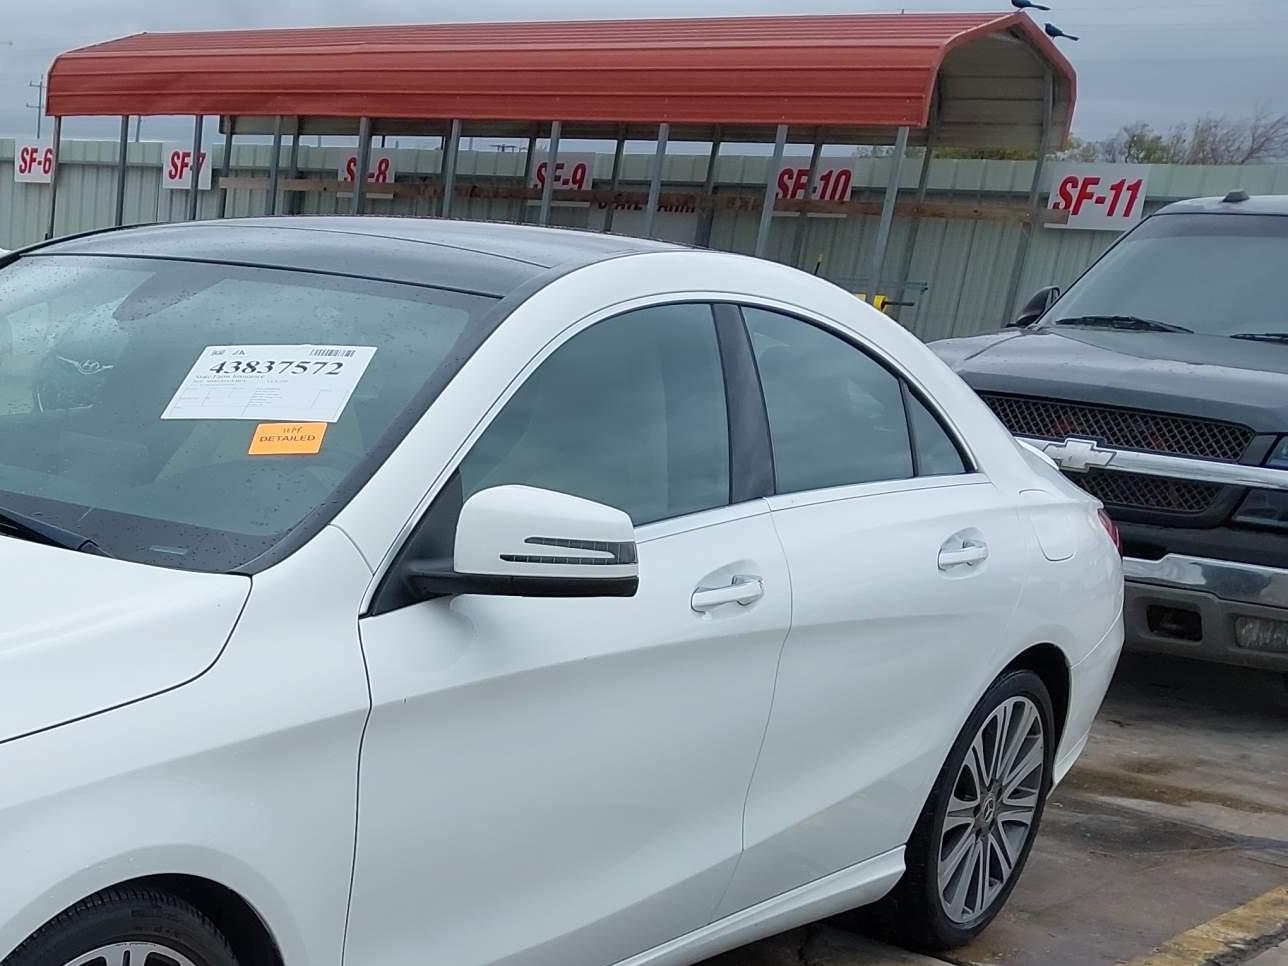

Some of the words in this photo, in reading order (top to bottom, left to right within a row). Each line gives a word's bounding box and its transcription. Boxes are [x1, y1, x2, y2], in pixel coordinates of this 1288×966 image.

[19, 147, 53, 174] SF-6
[344, 157, 389, 183] S-8
[1053, 176, 1143, 217] SF-11
[210, 360, 343, 375] 43837572
